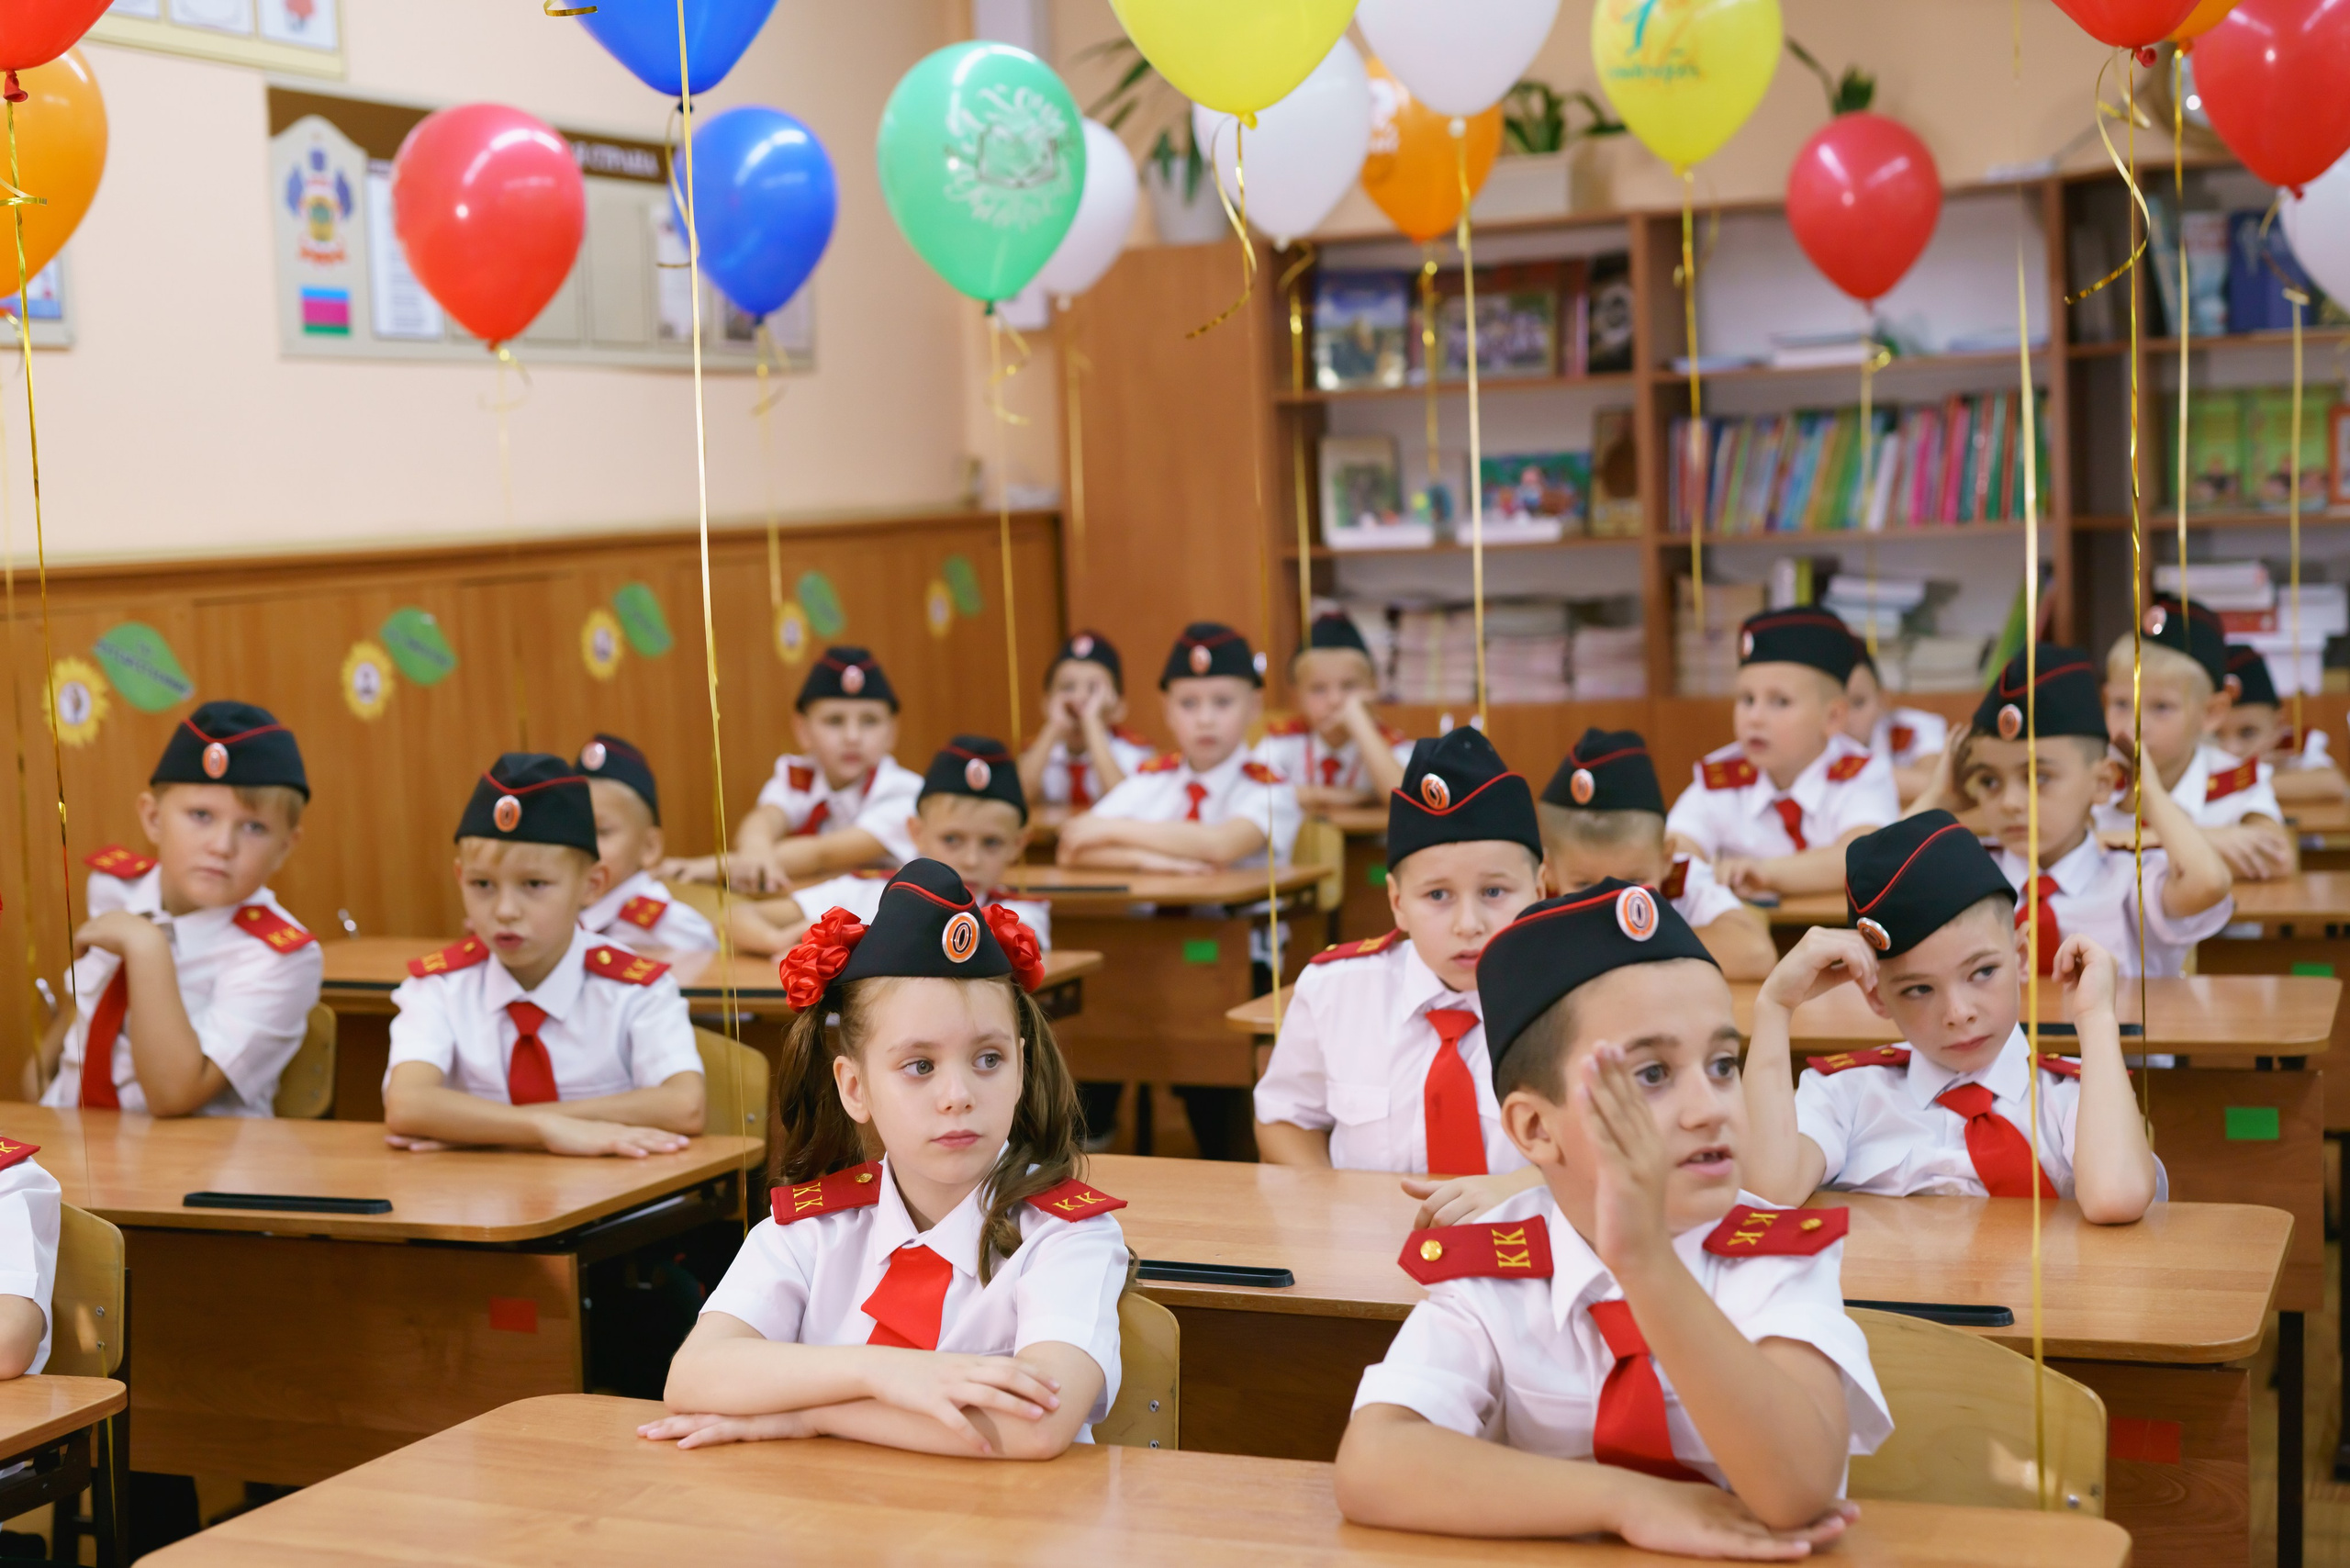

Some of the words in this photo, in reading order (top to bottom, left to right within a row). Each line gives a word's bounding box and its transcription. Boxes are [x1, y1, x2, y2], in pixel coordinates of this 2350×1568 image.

[792, 1182, 823, 1213] КК
[1052, 1191, 1107, 1211] КК
[1727, 1212, 1779, 1247] КК
[1491, 1226, 1531, 1269] КК
